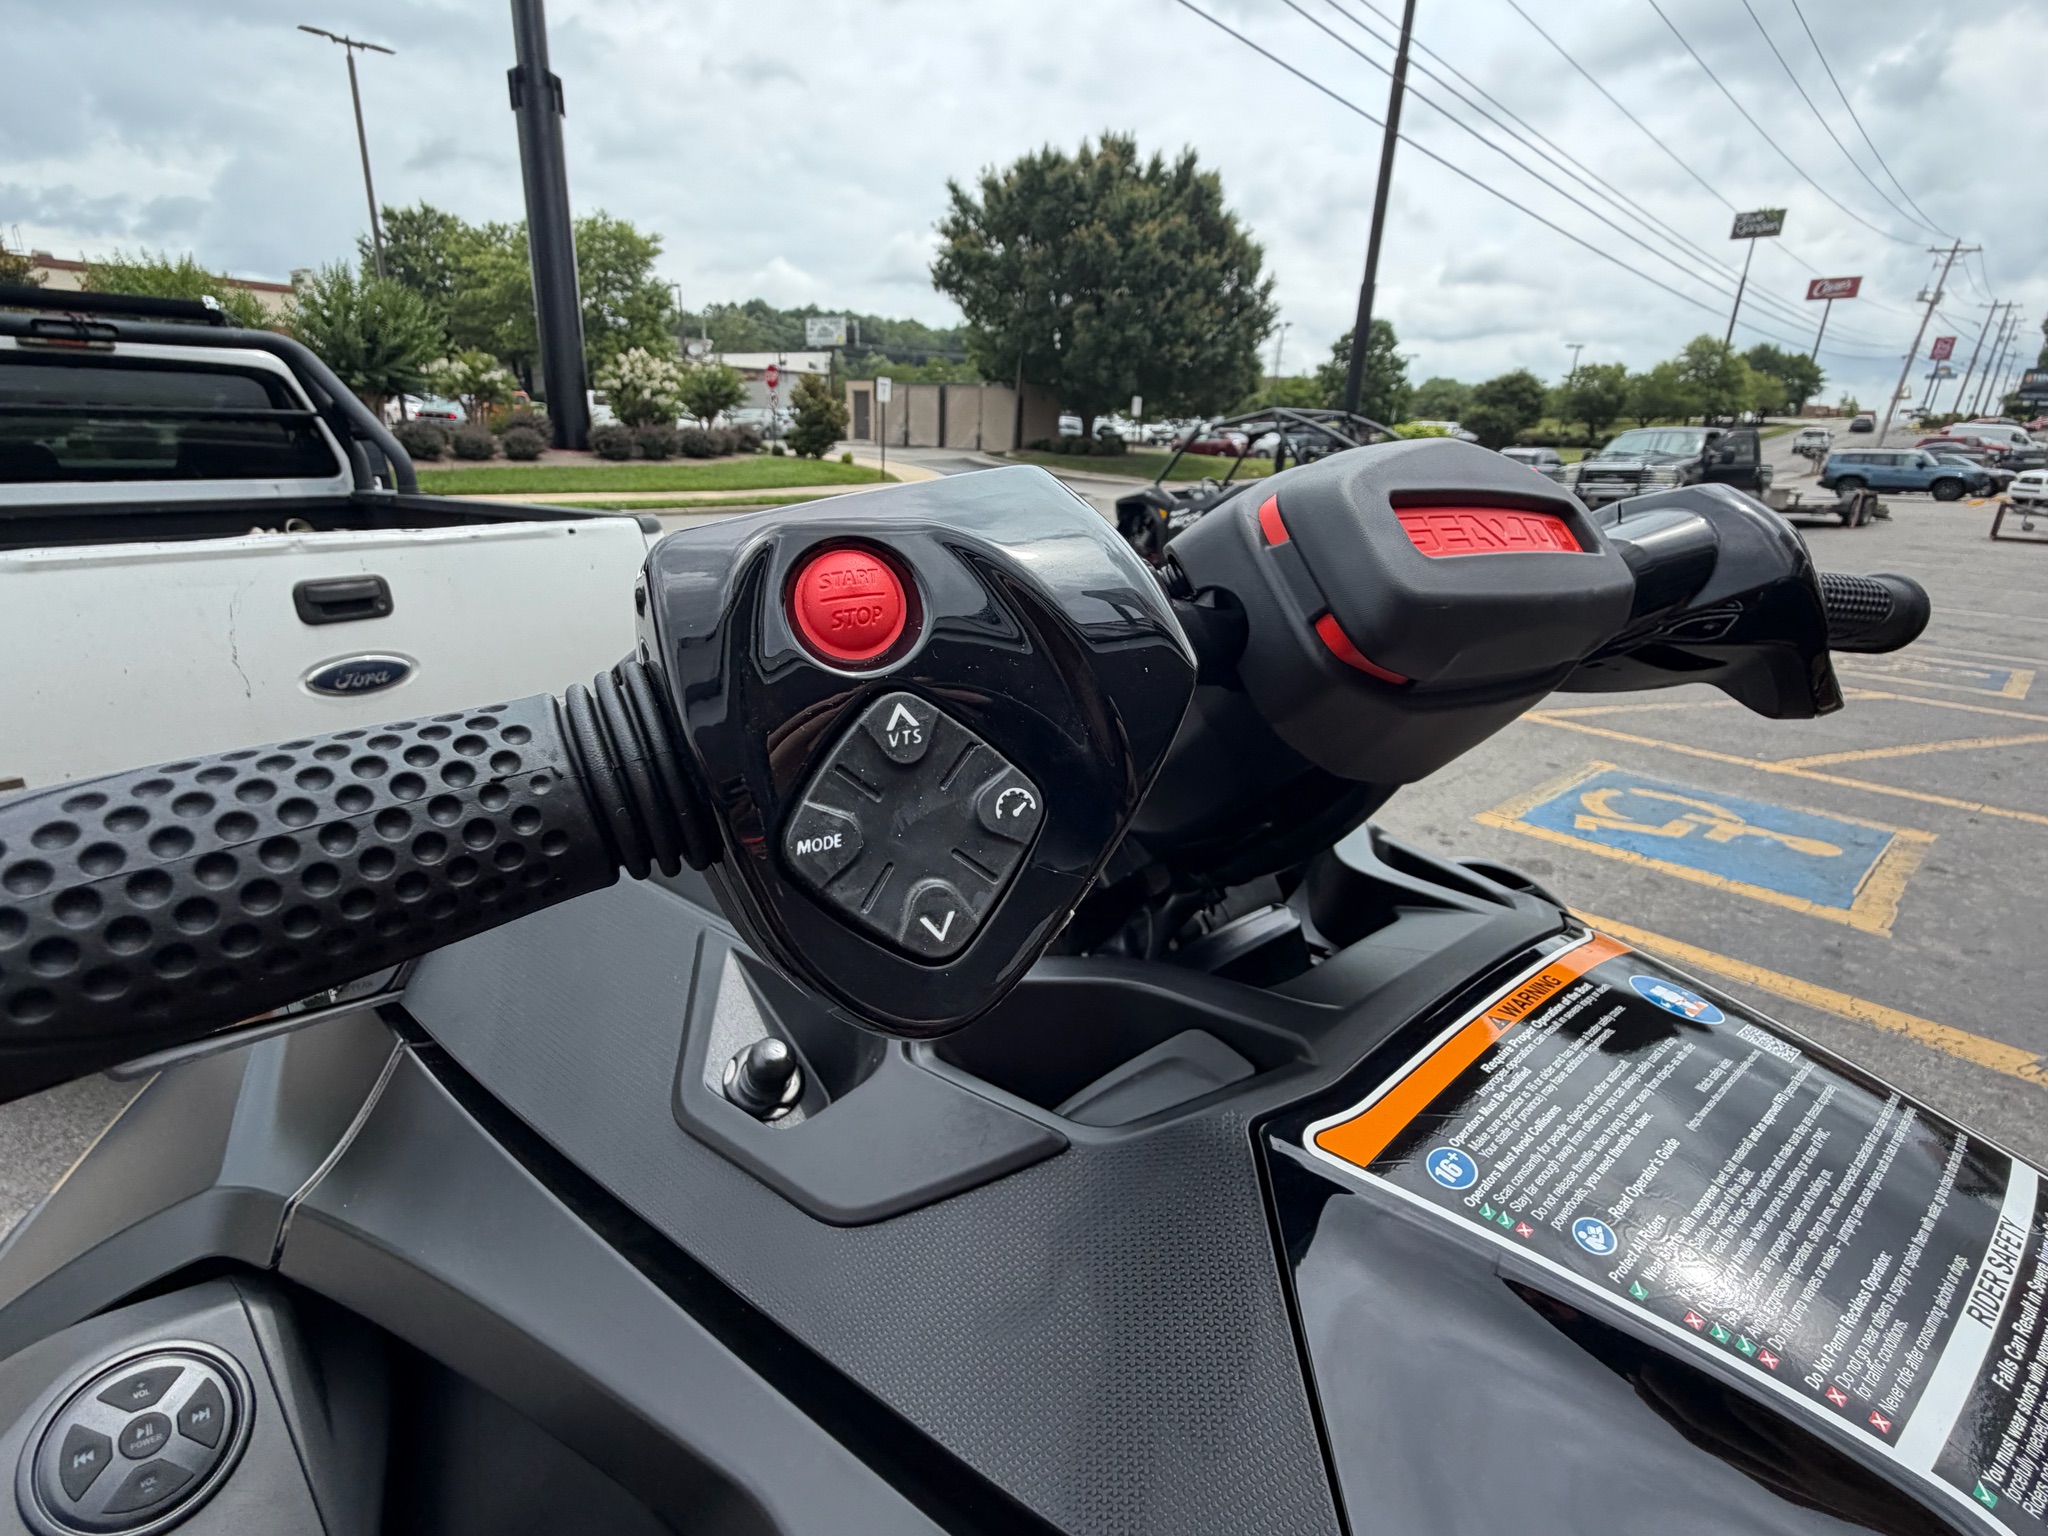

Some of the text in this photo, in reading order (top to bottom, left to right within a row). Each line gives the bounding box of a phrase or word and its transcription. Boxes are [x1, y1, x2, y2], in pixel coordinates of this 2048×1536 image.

[819, 568, 878, 590] START
[831, 605, 883, 631] STOP
[888, 728, 923, 748] VTS
[796, 833, 843, 856] MODE
[1497, 974, 1562, 1017] WARNING
[1475, 1033, 1547, 1097] Improper operation can
[1480, 1003, 1566, 1073] Require Proper Operation
[1448, 1066, 1532, 1147] Operators Must Be Qualified
[1467, 1065, 1556, 1152] Make sure operator older
[1478, 1049, 1589, 1158] Your state province) may additional
[1435, 1152, 1463, 1183] 16+
[1463, 1104, 1562, 1207] Operators Must Avoid Collisions
[1492, 1091, 1599, 1204] Scan constantly for people, objects and
[1509, 1086, 1626, 1212] Stay far enough away from others so you can
[1530, 1099, 1641, 1221] Do not release throttle when trying steer
[1550, 1112, 1654, 1231] powerboats, you need throttle to steer.
[1607, 1138, 1680, 1220] Read Operator's Guide
[1640, 1137, 1758, 1283] Wear with neoprene (wet suit material)
[1687, 1166, 1755, 1253] Safety section of this label.
[1710, 1154, 1786, 1256] read the Rider Safety section and
[1730, 1166, 1808, 1265] throttle when anyone boarding
[1759, 1176, 1831, 1273] are properly seated and holding
[1608, 1213, 1668, 1283] Protect All Riders
[1743, 1191, 1844, 1340] Avoid operation, sharp and
[1767, 1187, 1874, 1352] Do not jump waves or wakes jumping can cause
[1966, 1215, 2026, 1329] RIDER SAFETY
[2027, 1261, 2048, 1294] Severe
[1804, 1250, 1892, 1390] Do Not Permit Reckless Operation:
[1834, 1228, 1930, 1390] Do not go near others to spray or splash them
[1877, 1254, 1970, 1416] Never ride after consuming alcohol or drugs.
[2012, 1300, 2040, 1339] Result
[2023, 1291, 2043, 1311] in
[1852, 1319, 1908, 1401] for traffic conditions.
[1992, 1360, 2019, 1391] Falls
[2004, 1334, 2028, 1361] Can
[2027, 1361, 2046, 1384] with
[133, 1388, 151, 1399] VOL
[2007, 1410, 2029, 1440] wear
[2015, 1381, 2040, 1416] shorts
[130, 1433, 163, 1451] POWER
[1981, 1462, 2006, 1487] You
[1995, 1432, 2019, 1467] must
[2001, 1414, 2047, 1504] forcefully injected
[140, 1476, 157, 1488] VOL
